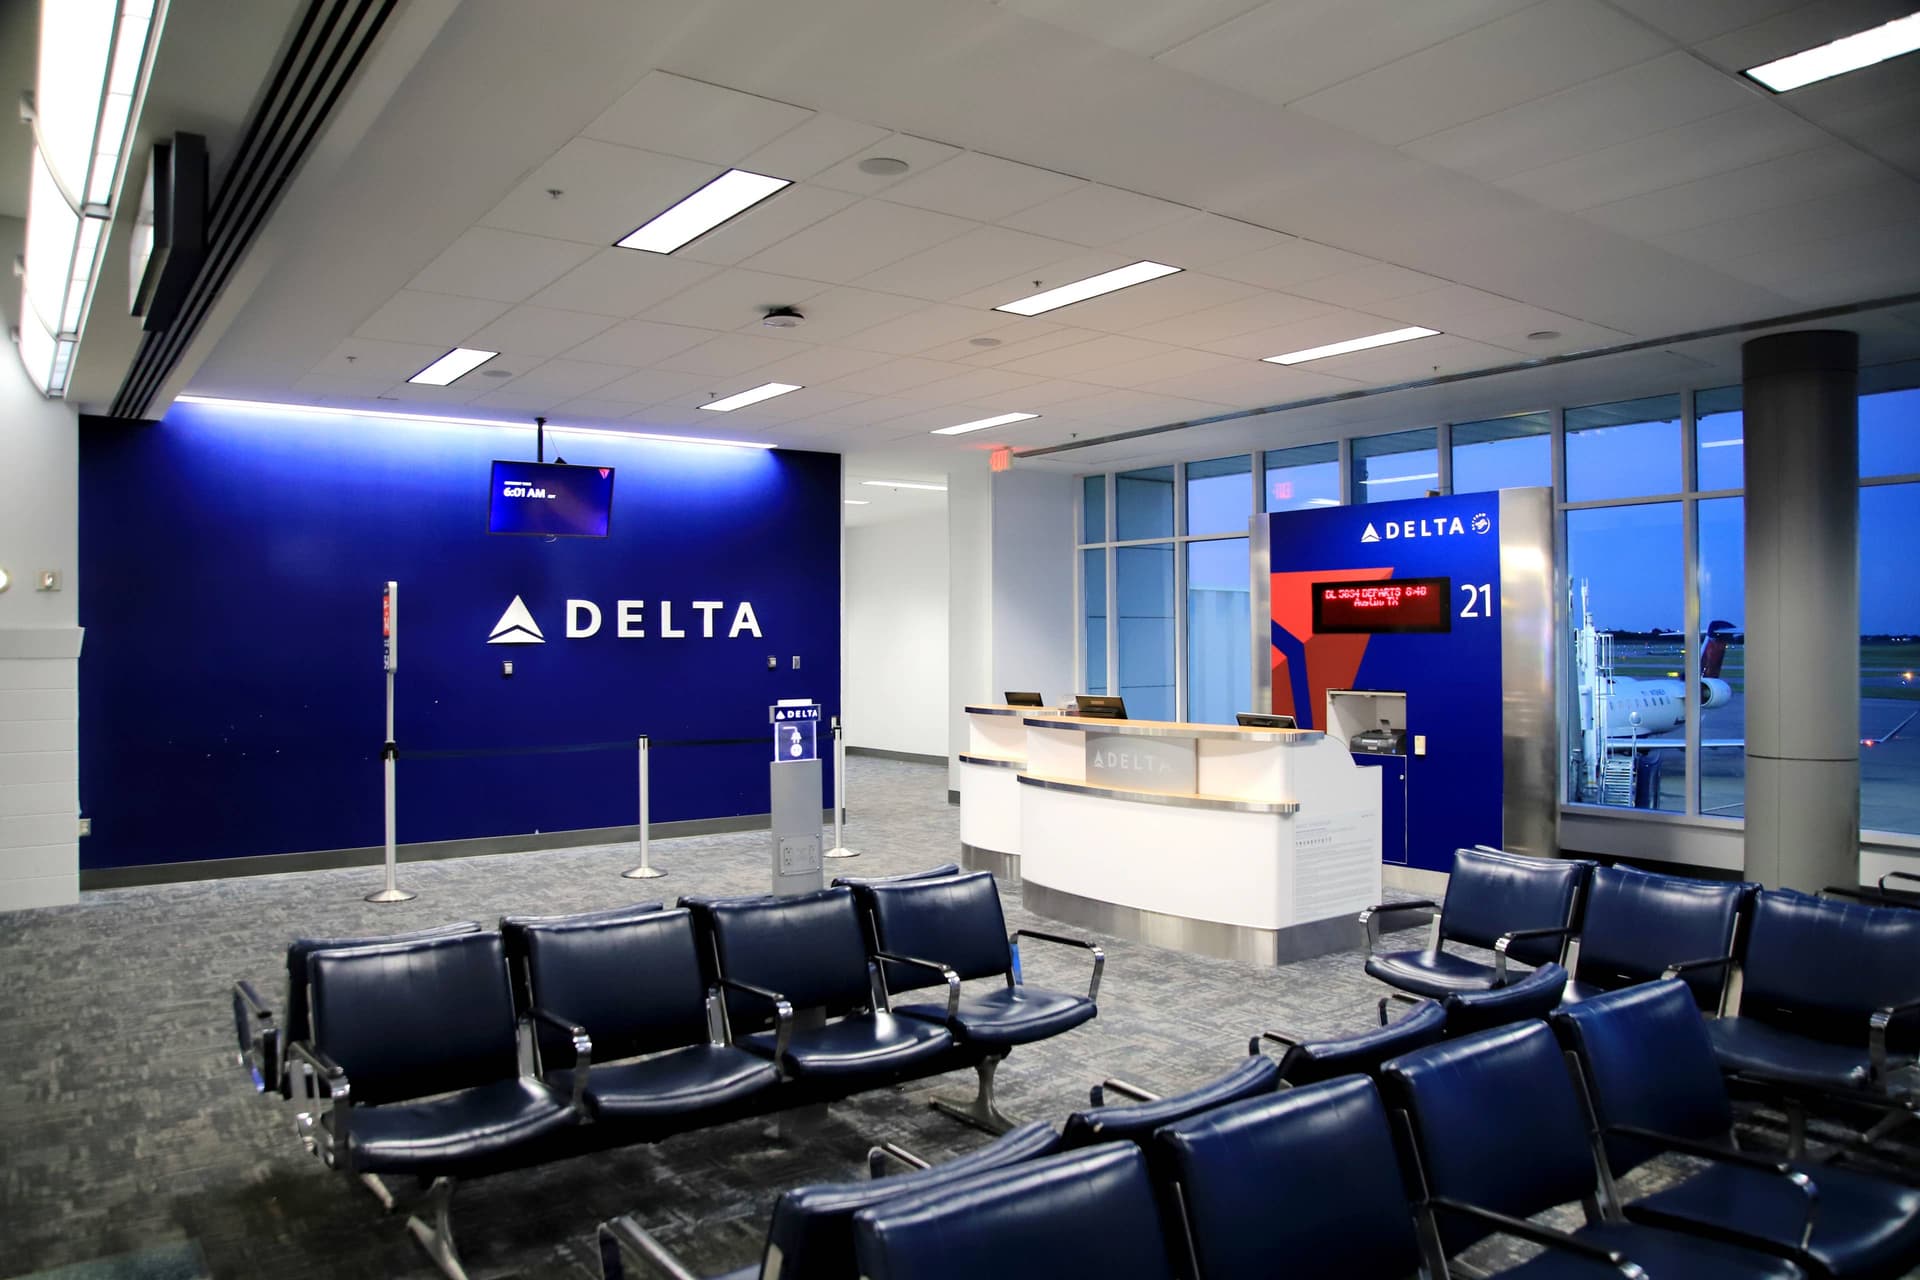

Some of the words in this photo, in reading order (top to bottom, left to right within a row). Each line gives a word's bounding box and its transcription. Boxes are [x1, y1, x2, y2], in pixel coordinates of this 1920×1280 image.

[503, 486, 526, 498] 6:01
[527, 488, 546, 499] AM
[1385, 517, 1465, 539] DELTA
[1362, 587, 1401, 598] DEPARTS
[1460, 583, 1492, 618] 21
[566, 599, 763, 638] DELTA
[787, 709, 818, 719] DELTA
